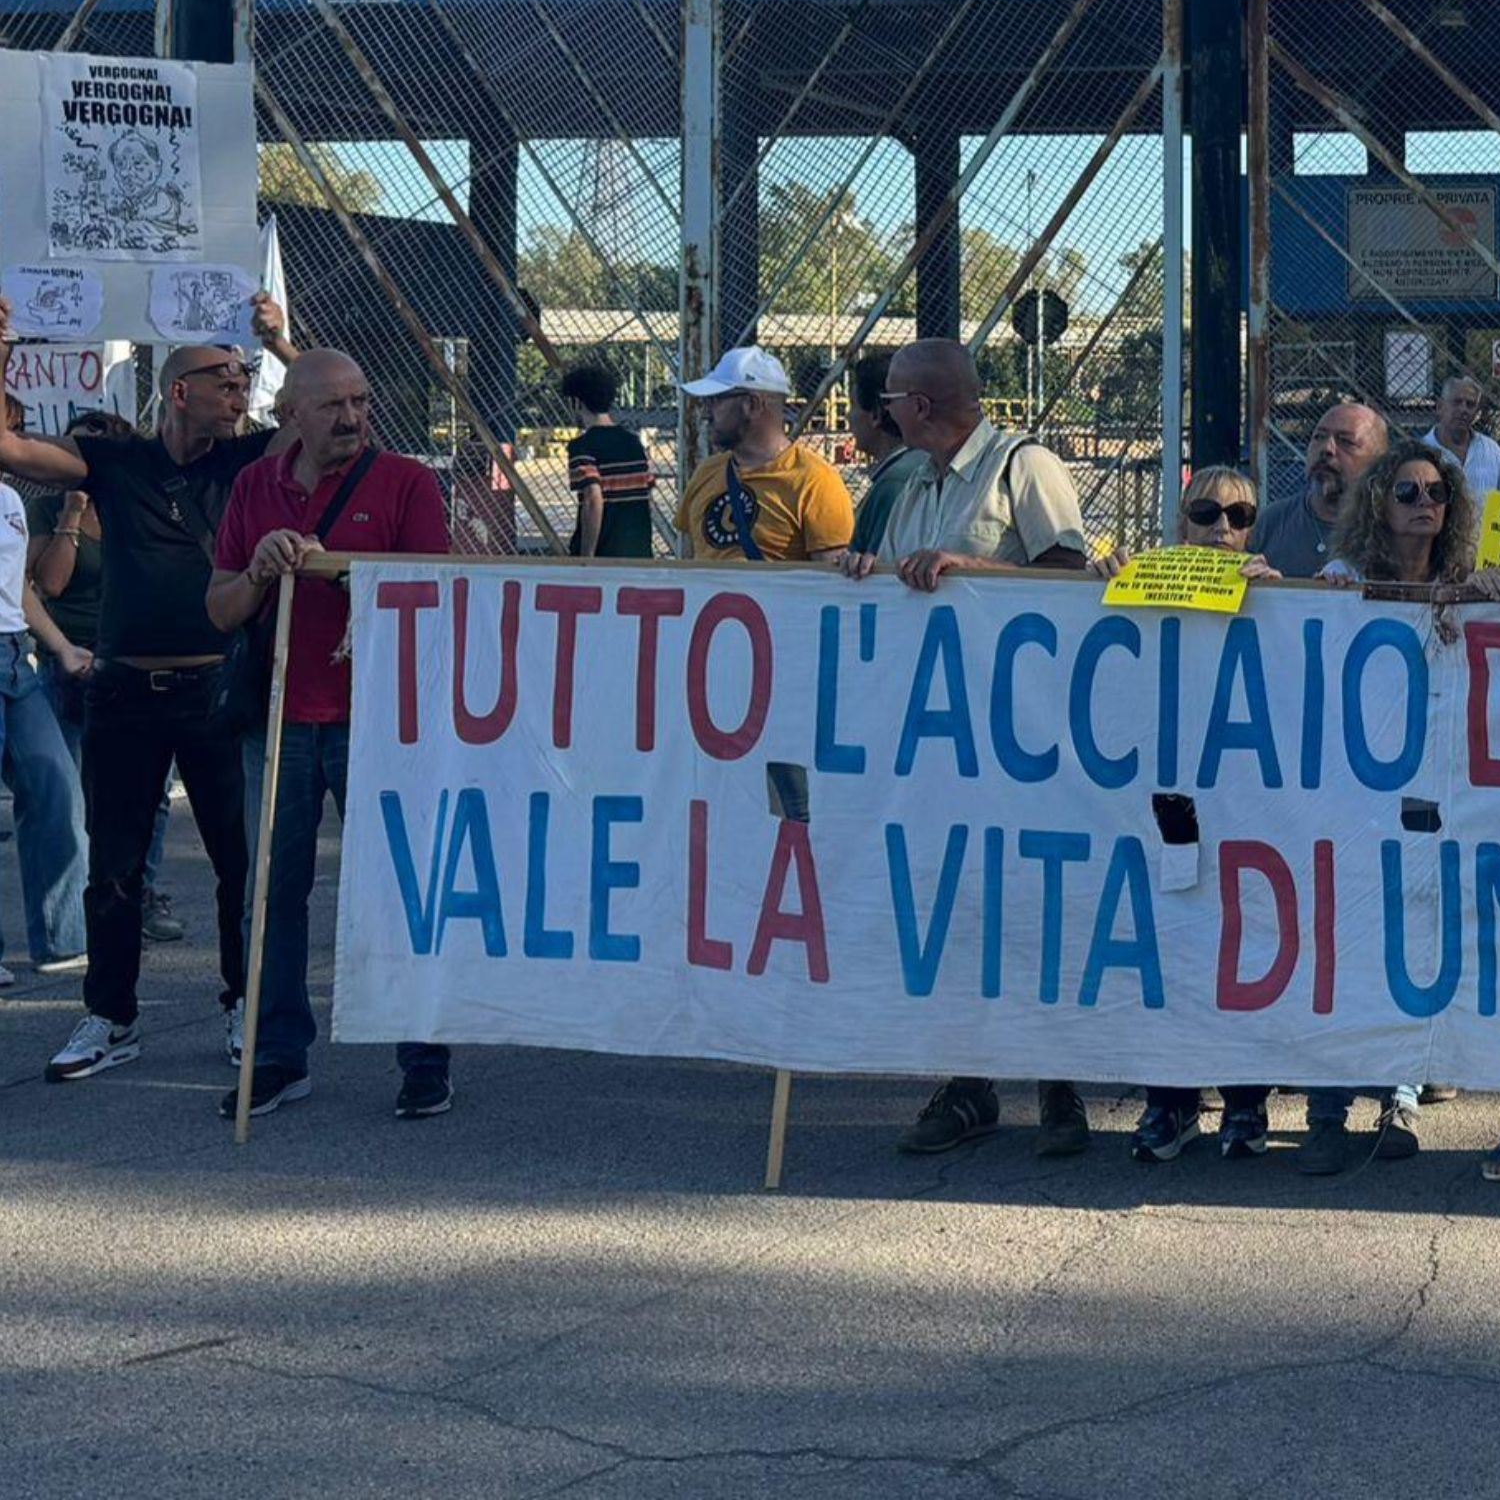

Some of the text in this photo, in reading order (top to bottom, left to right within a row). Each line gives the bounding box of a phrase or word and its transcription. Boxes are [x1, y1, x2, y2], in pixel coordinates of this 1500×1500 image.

[89, 65, 158, 81] VERGOGNA!
[72, 80, 172, 103] VERGOGNA!
[62, 100, 192, 128] VERGOGNA!
[1436, 191, 1489, 205] PRIVATA
[376, 577, 773, 762] TUTTO
[815, 602, 1429, 792] L'ACCIAIO
[379, 787, 644, 963] VALE
[686, 798, 830, 984] LA
[885, 823, 1165, 1011] VITA
[1216, 838, 1336, 1016] DI
